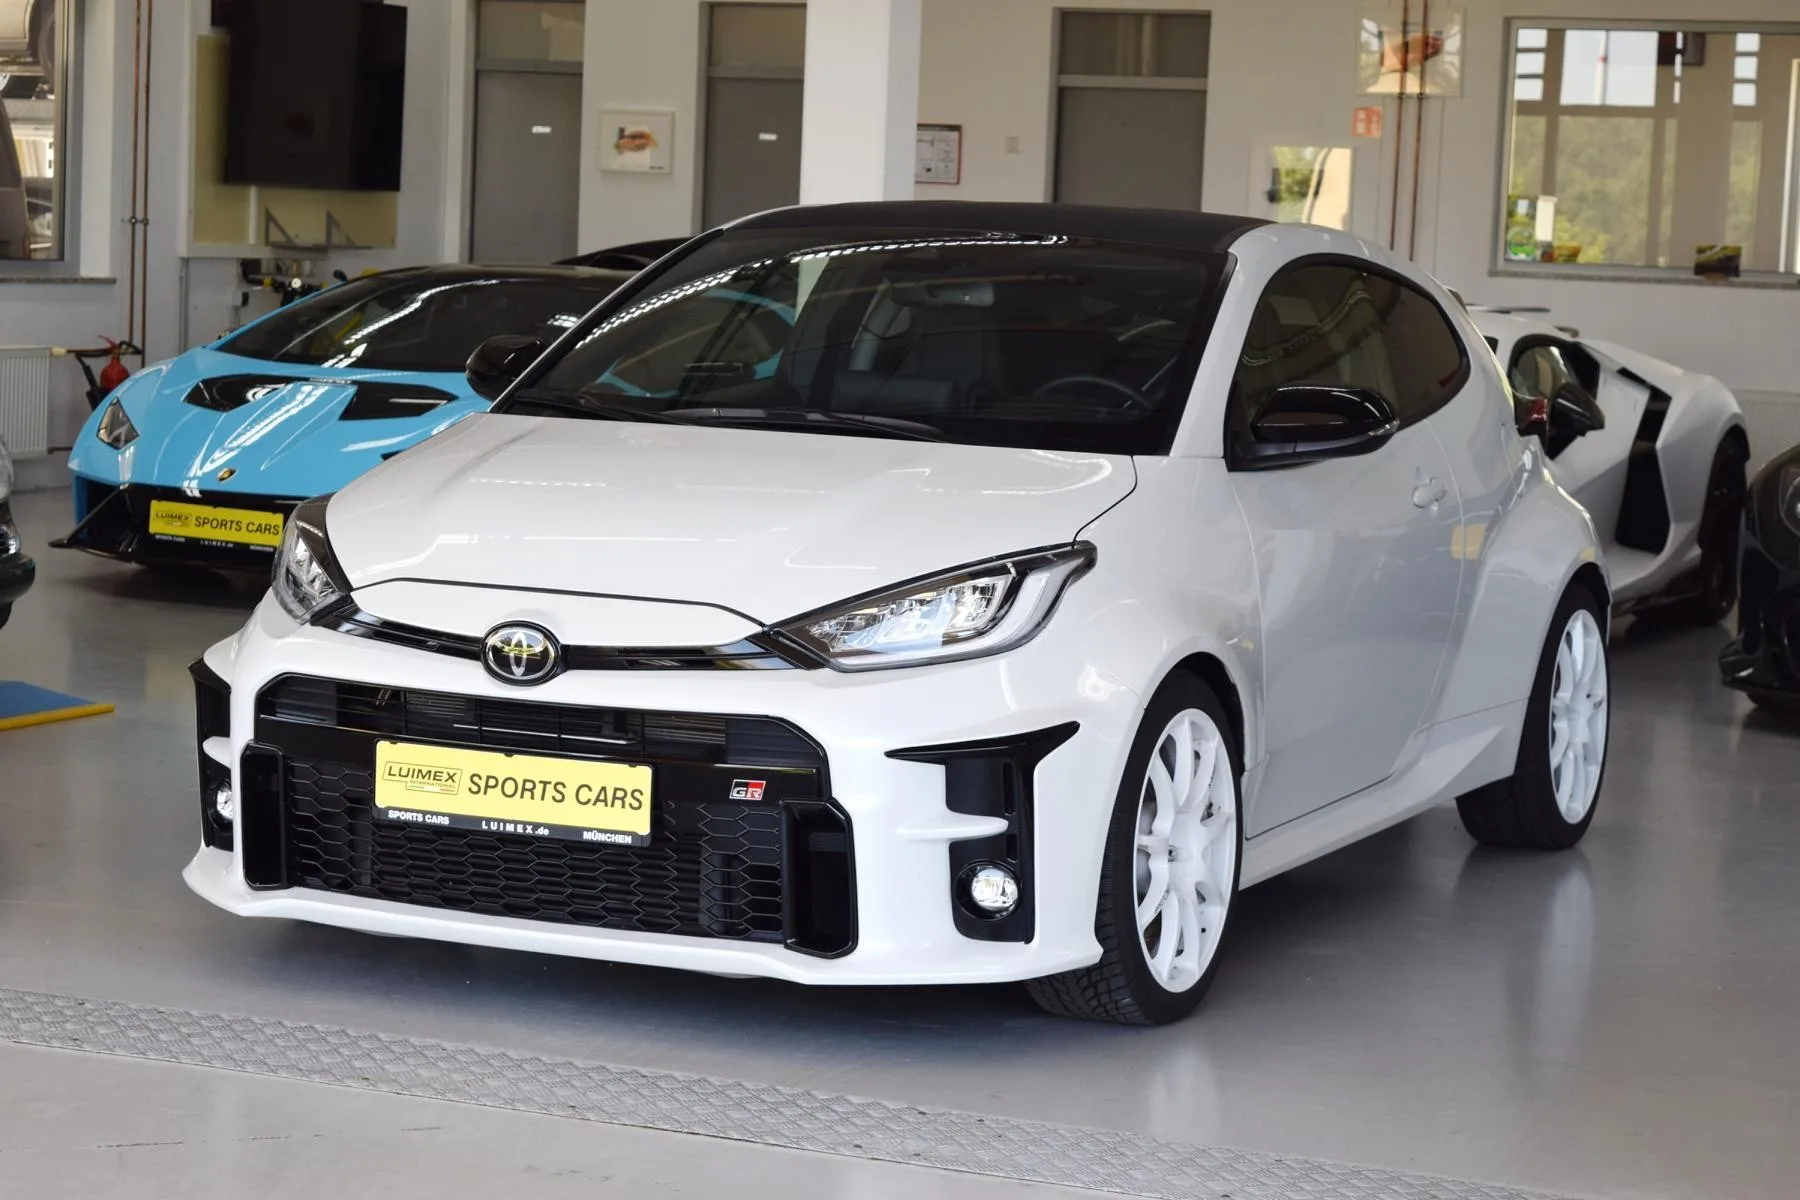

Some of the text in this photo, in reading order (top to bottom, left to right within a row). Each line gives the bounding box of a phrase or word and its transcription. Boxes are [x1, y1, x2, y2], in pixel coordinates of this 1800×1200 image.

[194, 515, 242, 532] SPORTS
[246, 521, 280, 536] CARS
[387, 765, 457, 784] LUIMEX
[468, 773, 644, 811] SPORTS CARS
[732, 786, 762, 799] GR
[388, 809, 450, 825] SPORTS CARS
[583, 830, 632, 844] MÜNCHEN
